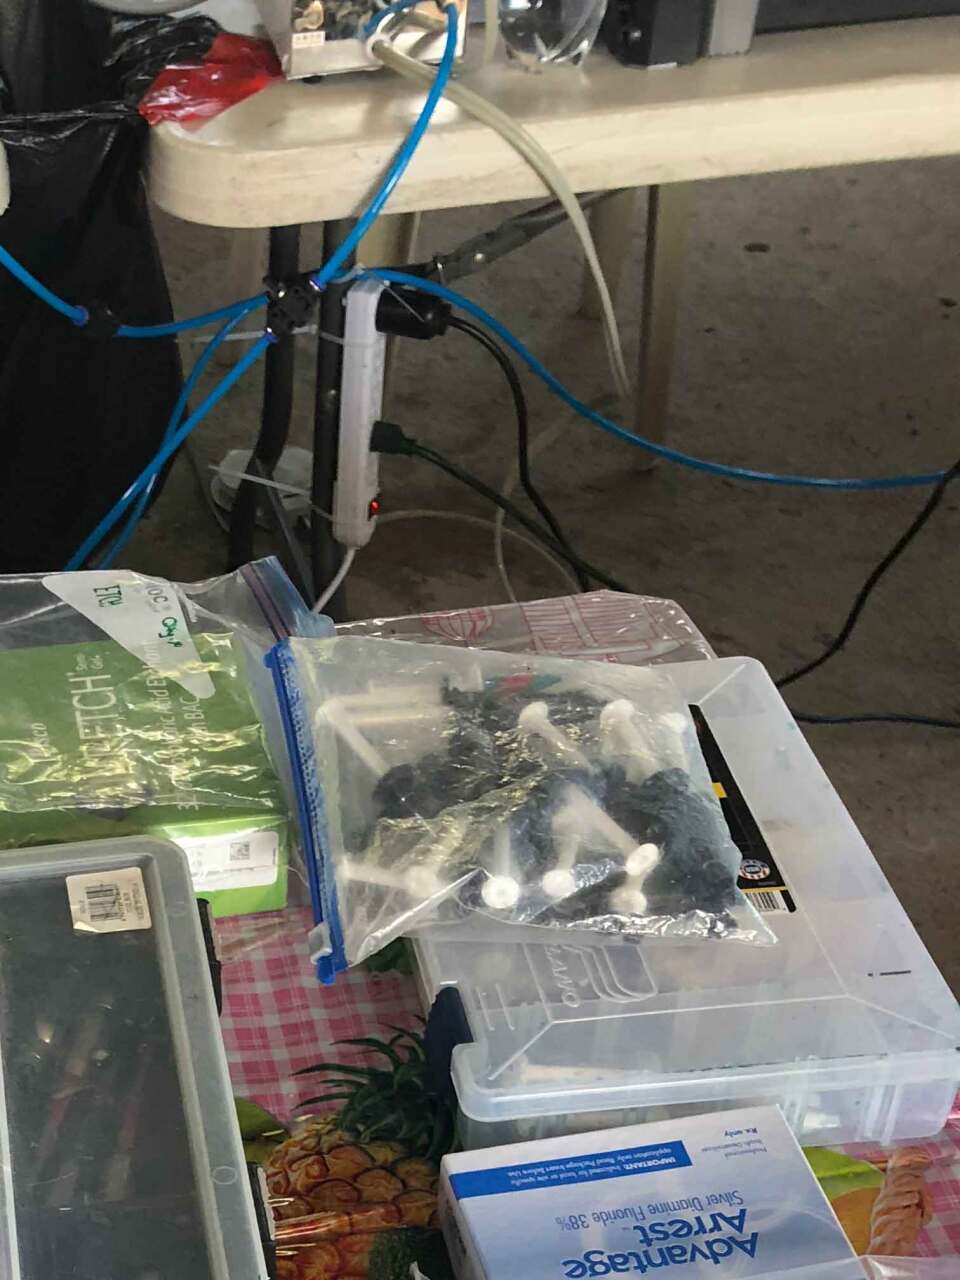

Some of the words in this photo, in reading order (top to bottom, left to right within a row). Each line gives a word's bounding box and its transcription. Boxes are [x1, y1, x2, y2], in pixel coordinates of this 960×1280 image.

[648, 1196, 703, 1214] Diamine
[708, 1190, 744, 1206] Silver
[554, 1214, 590, 1231] 38%
[592, 1205, 646, 1224] Fluoride
[633, 1208, 747, 1248] Arrest
[561, 1232, 759, 1280] Advantage
